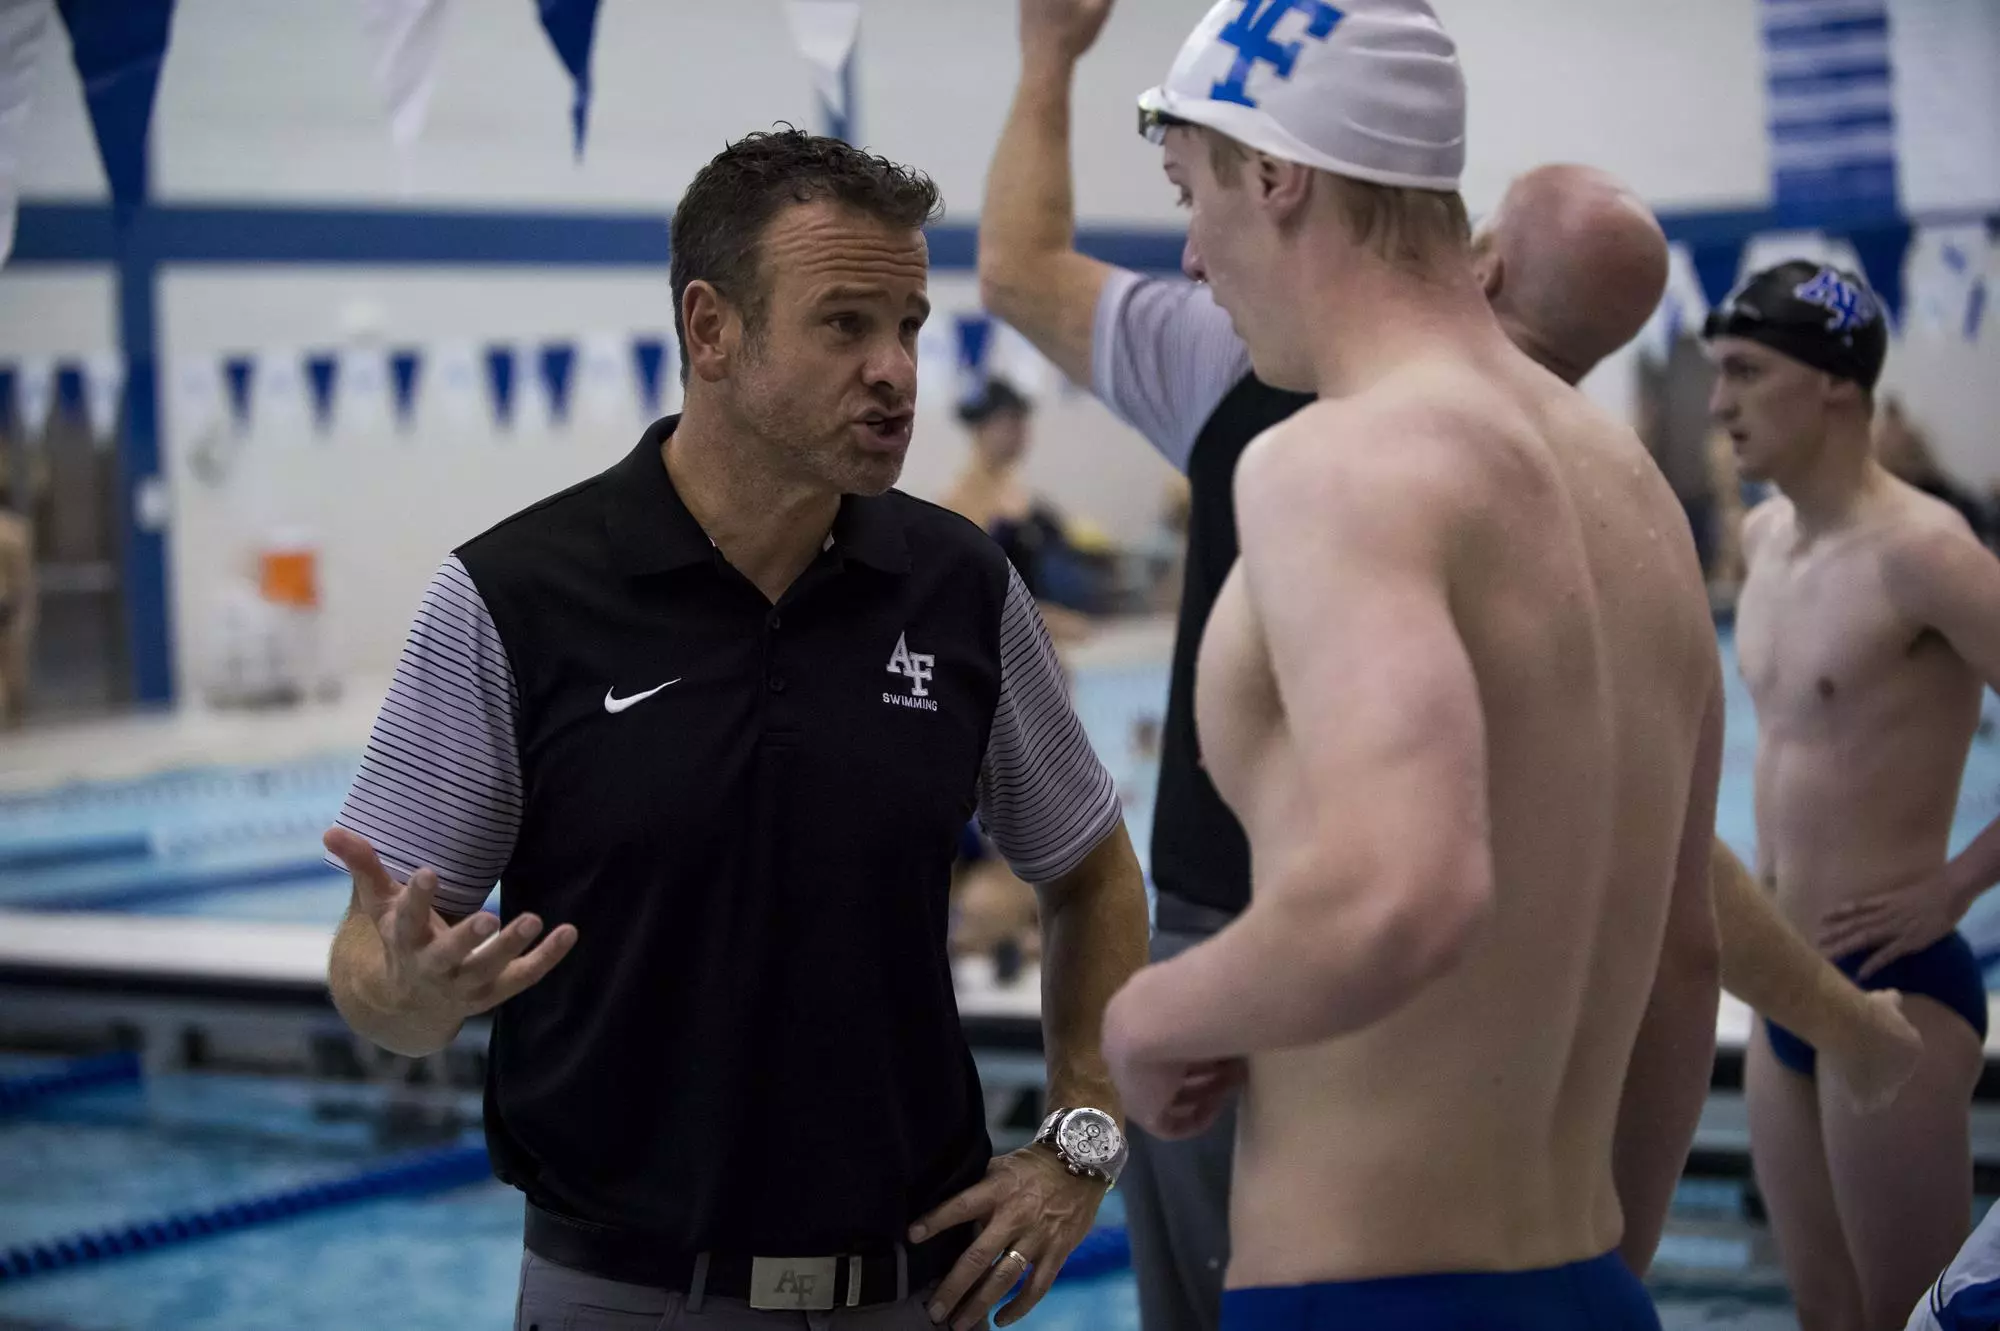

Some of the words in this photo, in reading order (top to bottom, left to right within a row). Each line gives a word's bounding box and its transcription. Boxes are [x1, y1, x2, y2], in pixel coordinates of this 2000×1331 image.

[886, 630, 936, 696] AF
[882, 692, 938, 711] SWIMMING
[774, 1268, 818, 1307] AF
